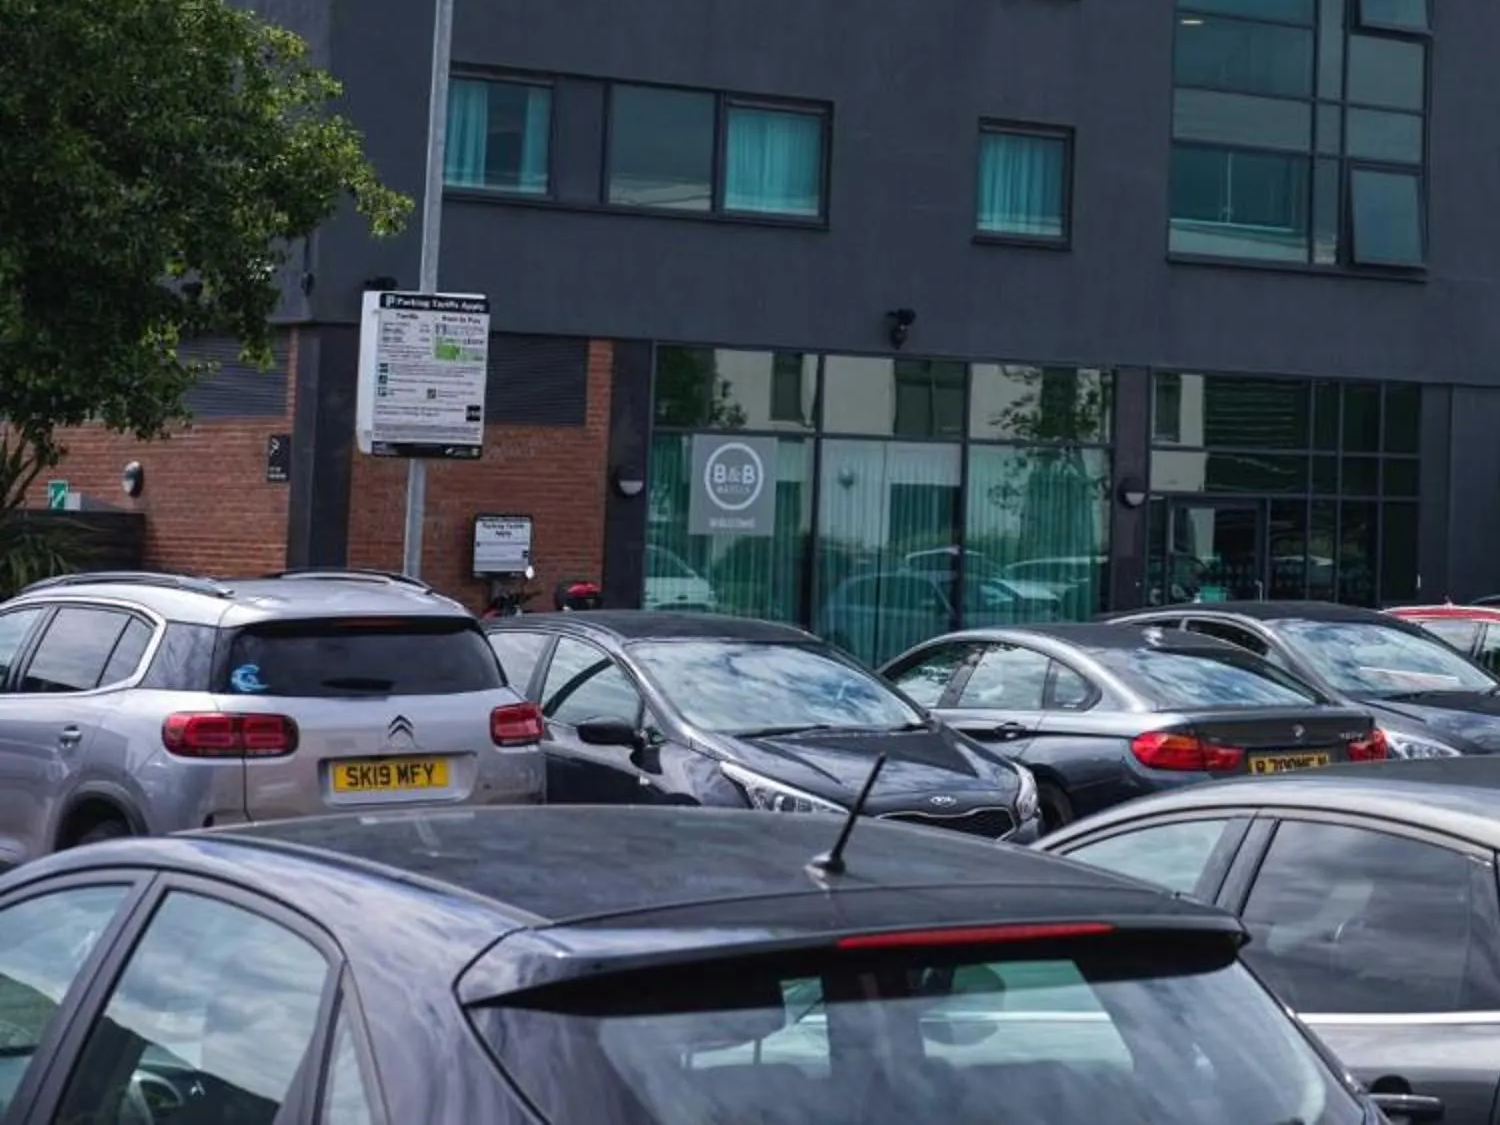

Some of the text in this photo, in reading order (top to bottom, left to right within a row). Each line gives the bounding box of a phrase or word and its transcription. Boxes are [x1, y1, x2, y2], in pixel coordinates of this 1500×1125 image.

[713, 463, 756, 485] B&B
[346, 762, 436, 787] SK19 MFY
